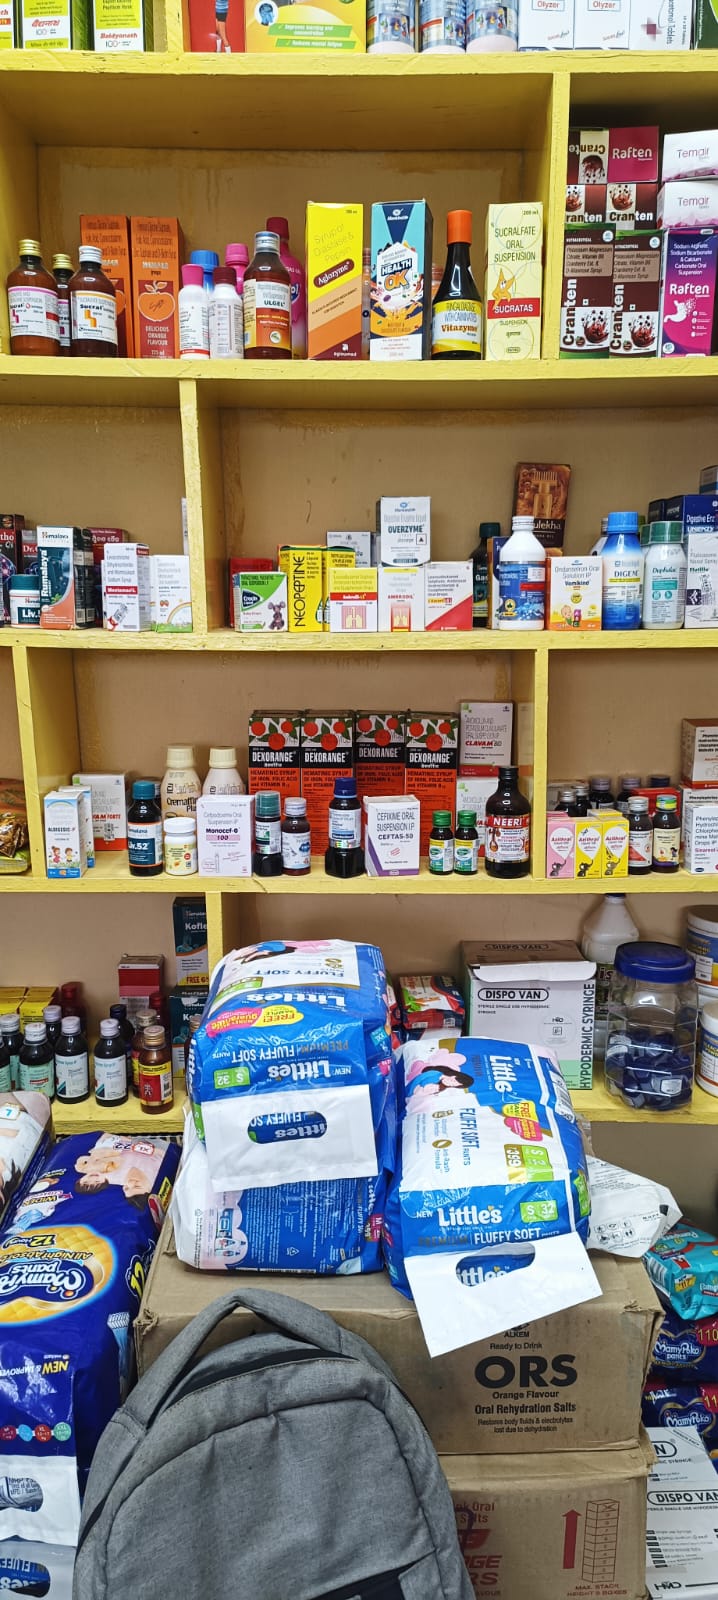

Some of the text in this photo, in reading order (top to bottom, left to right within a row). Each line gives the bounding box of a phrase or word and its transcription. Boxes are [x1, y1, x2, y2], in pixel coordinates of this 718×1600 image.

[537, 1, 560, 9] Olyzer
[592, 1, 616, 9] Olyzer
[612, 148, 652, 159] Raften
[677, 148, 709, 159] Temair
[677, 197, 709, 208] Temair
[609, 211, 653, 222] Cranten
[495, 226, 537, 238] SUCRALFATE
[506, 241, 524, 250] ORAL
[495, 252, 536, 263] SUSPENSION
[381, 258, 412, 276] HEALTH
[317, 264, 349, 285] Aglozyme
[678, 269, 703, 277] Suspension
[384, 271, 409, 291] OK
[670, 283, 709, 295] Raften
[264, 300, 285, 308] ULGEL
[494, 304, 533, 314] SUCRATAS
[563, 279, 577, 346] Cranten
[610, 285, 624, 351] Cranten
[388, 526, 423, 534] OVERZYME
[41, 549, 50, 598] Rumalaya
[293, 556, 306, 627] NEOPEPTINE
[252, 751, 294, 762] DEXORANGE
[304, 752, 346, 763] DEXORANGE
[358, 747, 399, 759] DEXORANGE
[409, 752, 451, 764] DEXORANGE
[376, 811, 416, 821] CEFIXIME ORAL
[376, 822, 407, 832] SUSPENSION
[493, 818, 522, 826] NEERI
[291, 970, 344, 978] FLUFFY
[186, 976, 200, 984] FREE
[485, 990, 541, 1000] DISPO VAN
[580, 983, 595, 1090] HYPODERMIC SYRINGE
[231, 1049, 257, 1063] SOFT
[258, 1045, 295, 1061] FLUFFY
[334, 1066, 352, 1075] NEW
[217, 1072, 244, 1085] S 32
[460, 1108, 476, 1130] FLUFFY
[275, 1124, 326, 1139] ittles
[462, 1131, 480, 1149] SOFT
[113, 1142, 131, 1150] 22
[416, 1211, 434, 1220] NEW
[527, 1206, 534, 1217] S
[541, 1204, 554, 1217] 32
[30, 1236, 53, 1247] 12
[418, 1237, 468, 1248] PREMIUM
[474, 1231, 510, 1245] FLUFFY
[514, 1227, 541, 1244] SOFT
[12, 1261, 58, 1274] pants
[490, 1342, 543, 1352] Ready to Drink
[655, 1341, 700, 1355] MamyPoko
[42, 1361, 69, 1375] NEW
[474, 1353, 578, 1389] ORS
[492, 1390, 560, 1401] Orange Flavour
[475, 1402, 577, 1416] Oral Rehydration Salts
[504, 1417, 519, 1427] body
[541, 1416, 574, 1425] electrolytes
[494, 1426, 505, 1434] lost
[525, 1425, 558, 1434] dehydration
[656, 1493, 694, 1504] DISPO
[471, 1502, 495, 1512] Oral
